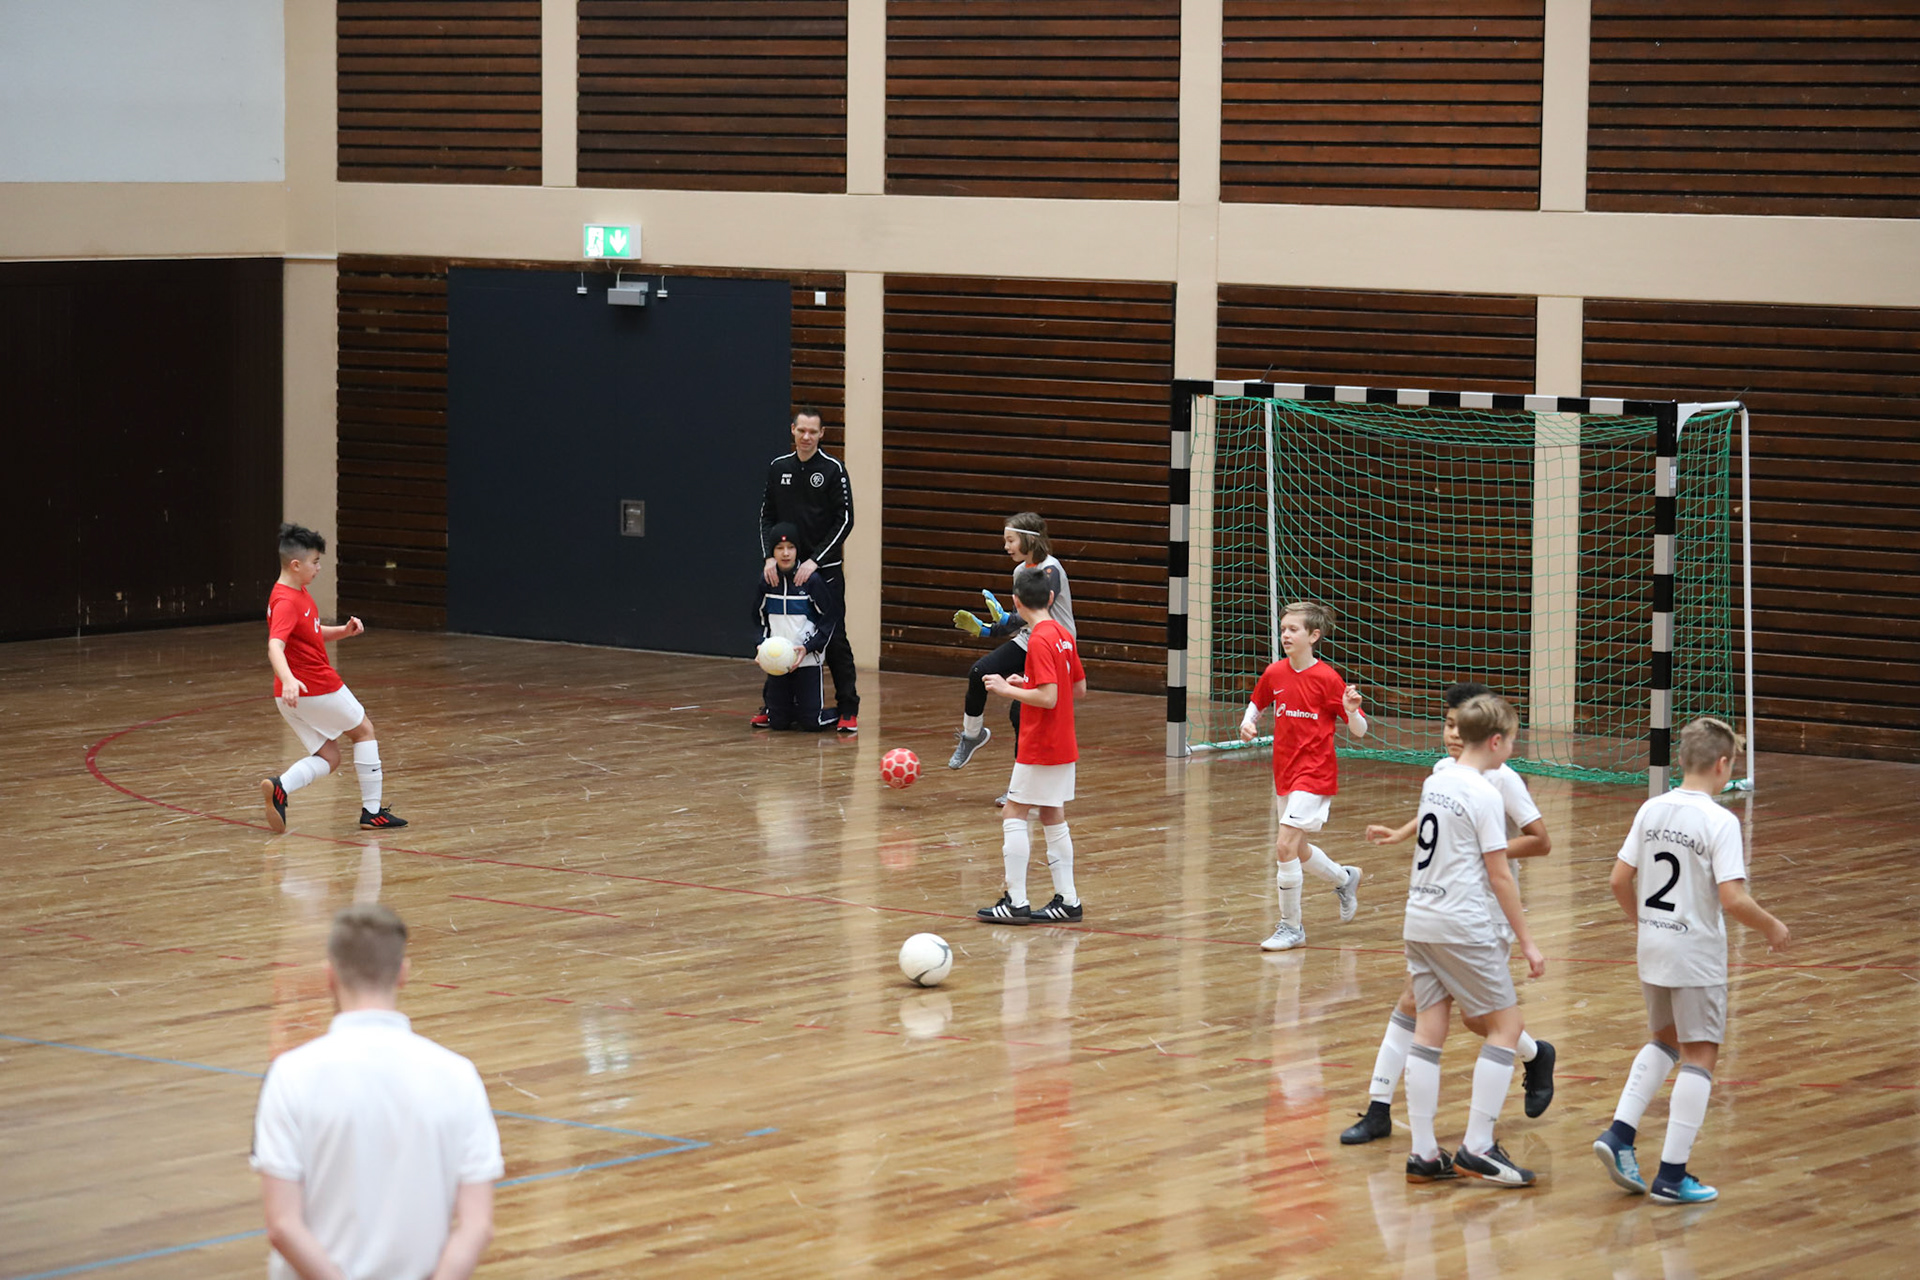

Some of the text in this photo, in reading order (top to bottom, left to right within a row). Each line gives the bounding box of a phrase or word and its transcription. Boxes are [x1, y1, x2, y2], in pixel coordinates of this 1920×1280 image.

[1417, 812, 1439, 870] 9
[1644, 829, 1661, 843] SK
[1644, 851, 1680, 912] 2
